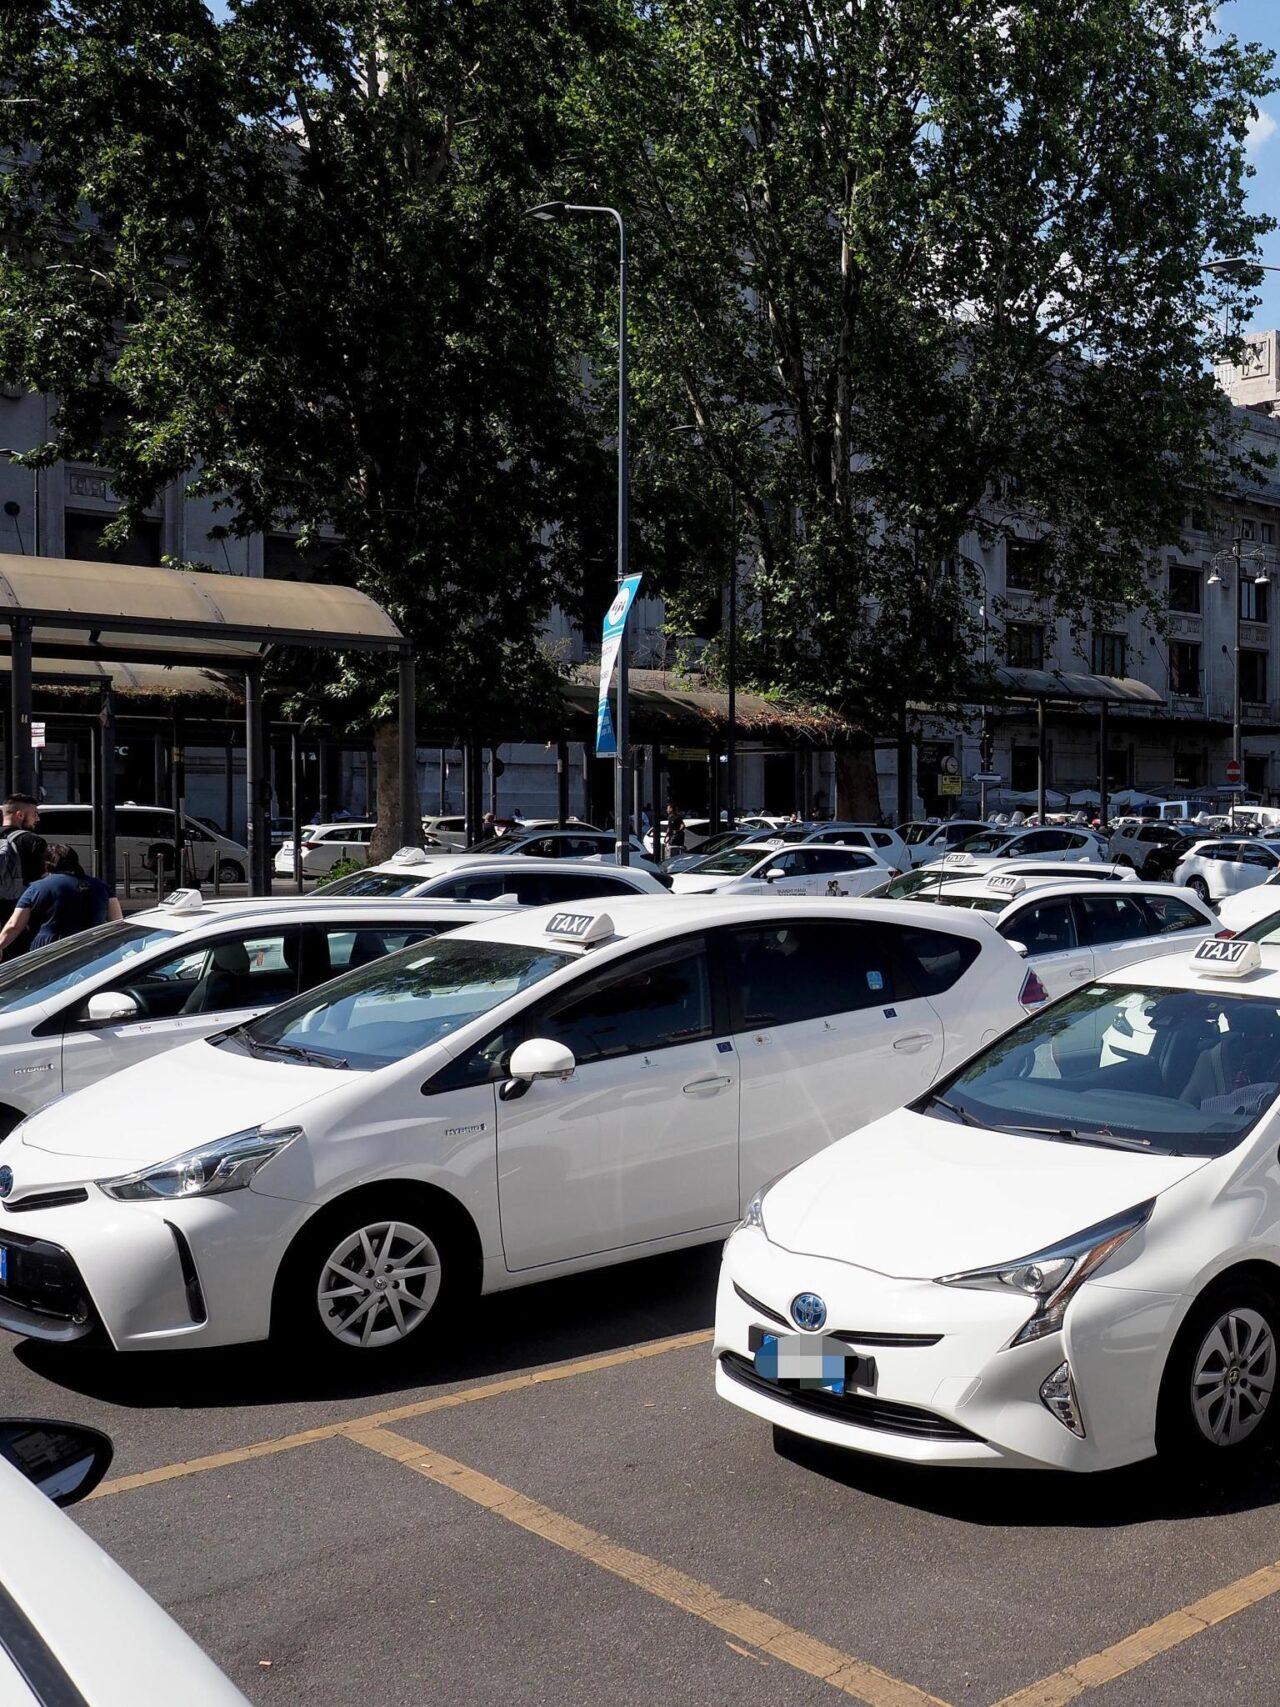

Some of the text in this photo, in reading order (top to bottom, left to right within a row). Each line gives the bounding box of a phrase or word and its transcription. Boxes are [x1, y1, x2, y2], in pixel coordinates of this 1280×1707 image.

[990, 876, 1013, 888] TAXI
[551, 915, 589, 932] TAXI
[1201, 942, 1245, 960] TAXI
